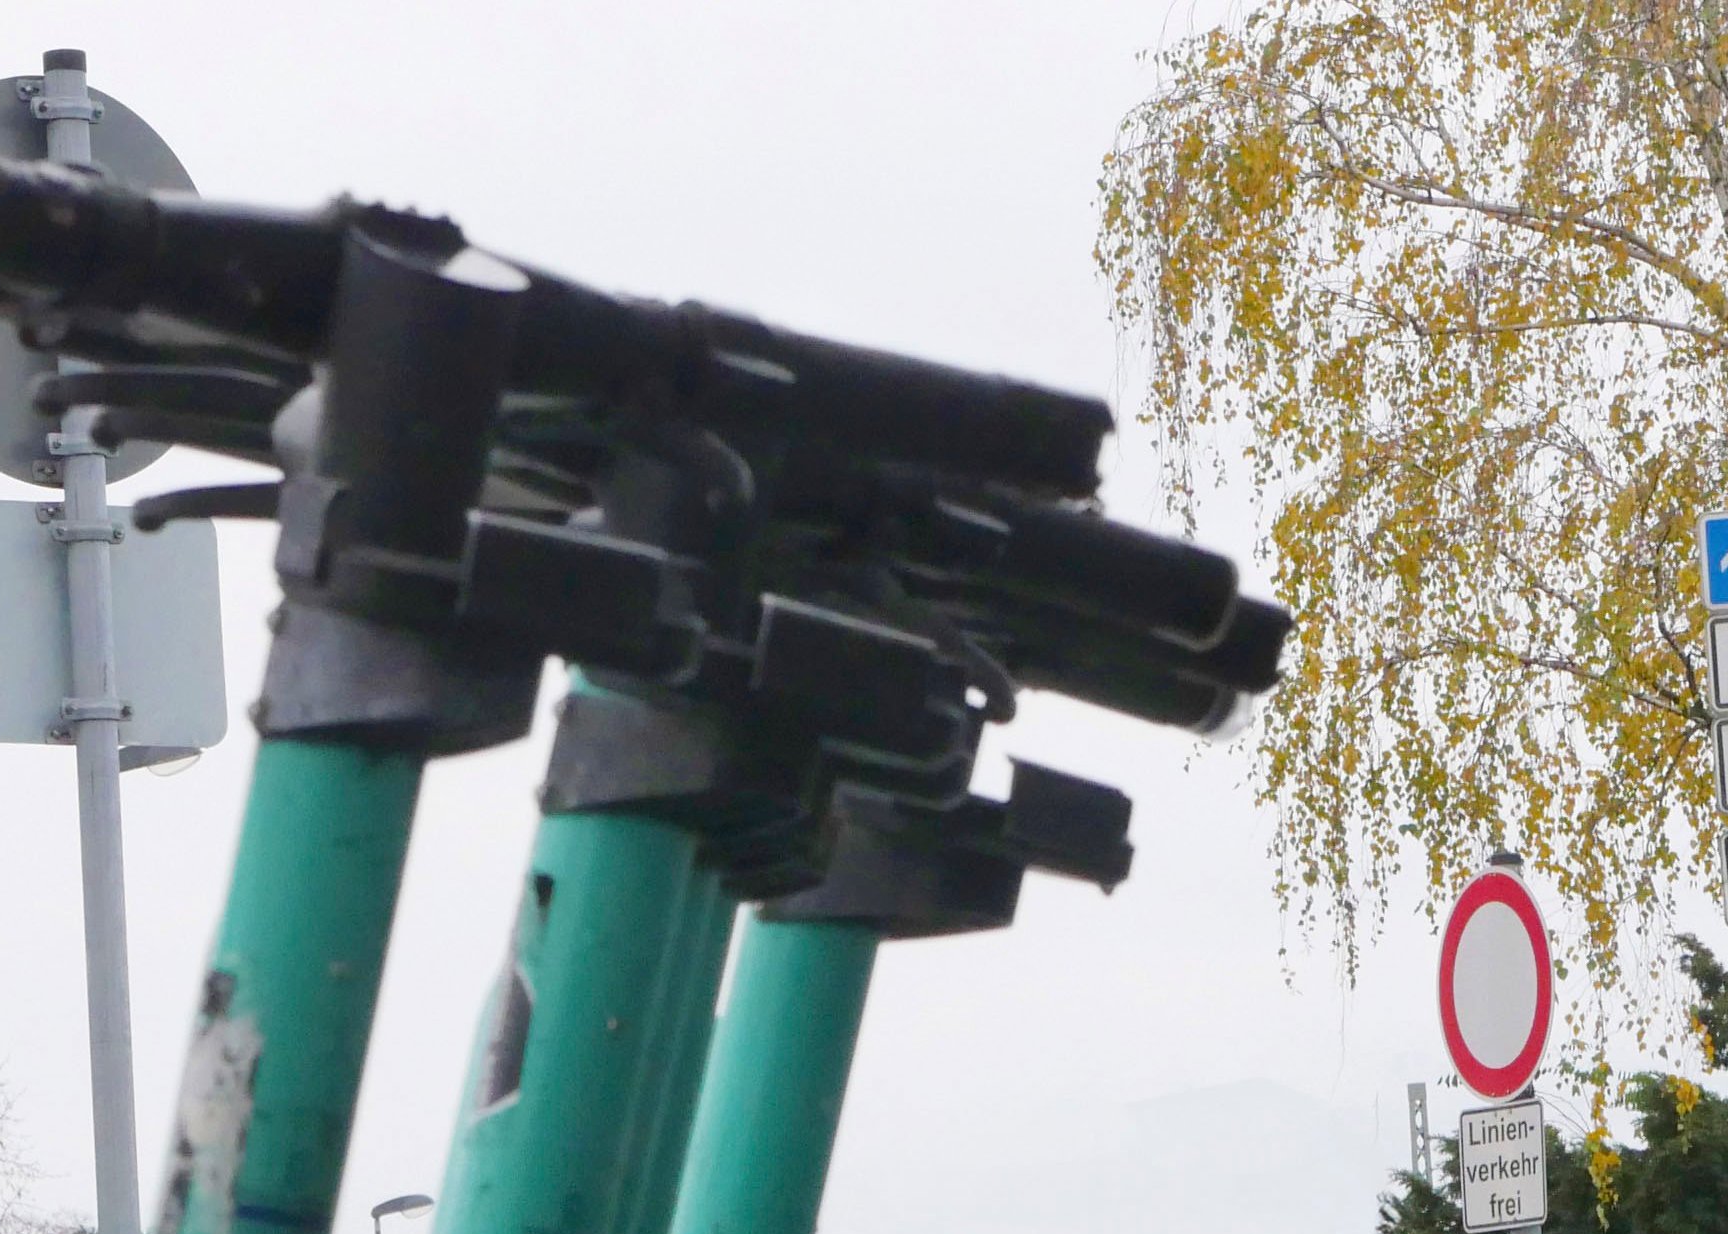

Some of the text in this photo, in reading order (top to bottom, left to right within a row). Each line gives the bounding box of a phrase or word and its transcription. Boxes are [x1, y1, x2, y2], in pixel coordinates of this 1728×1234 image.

[1468, 1117, 1535, 1146] Linien-
[1466, 1152, 1540, 1184] verkehr
[1489, 1190, 1522, 1219] frei
